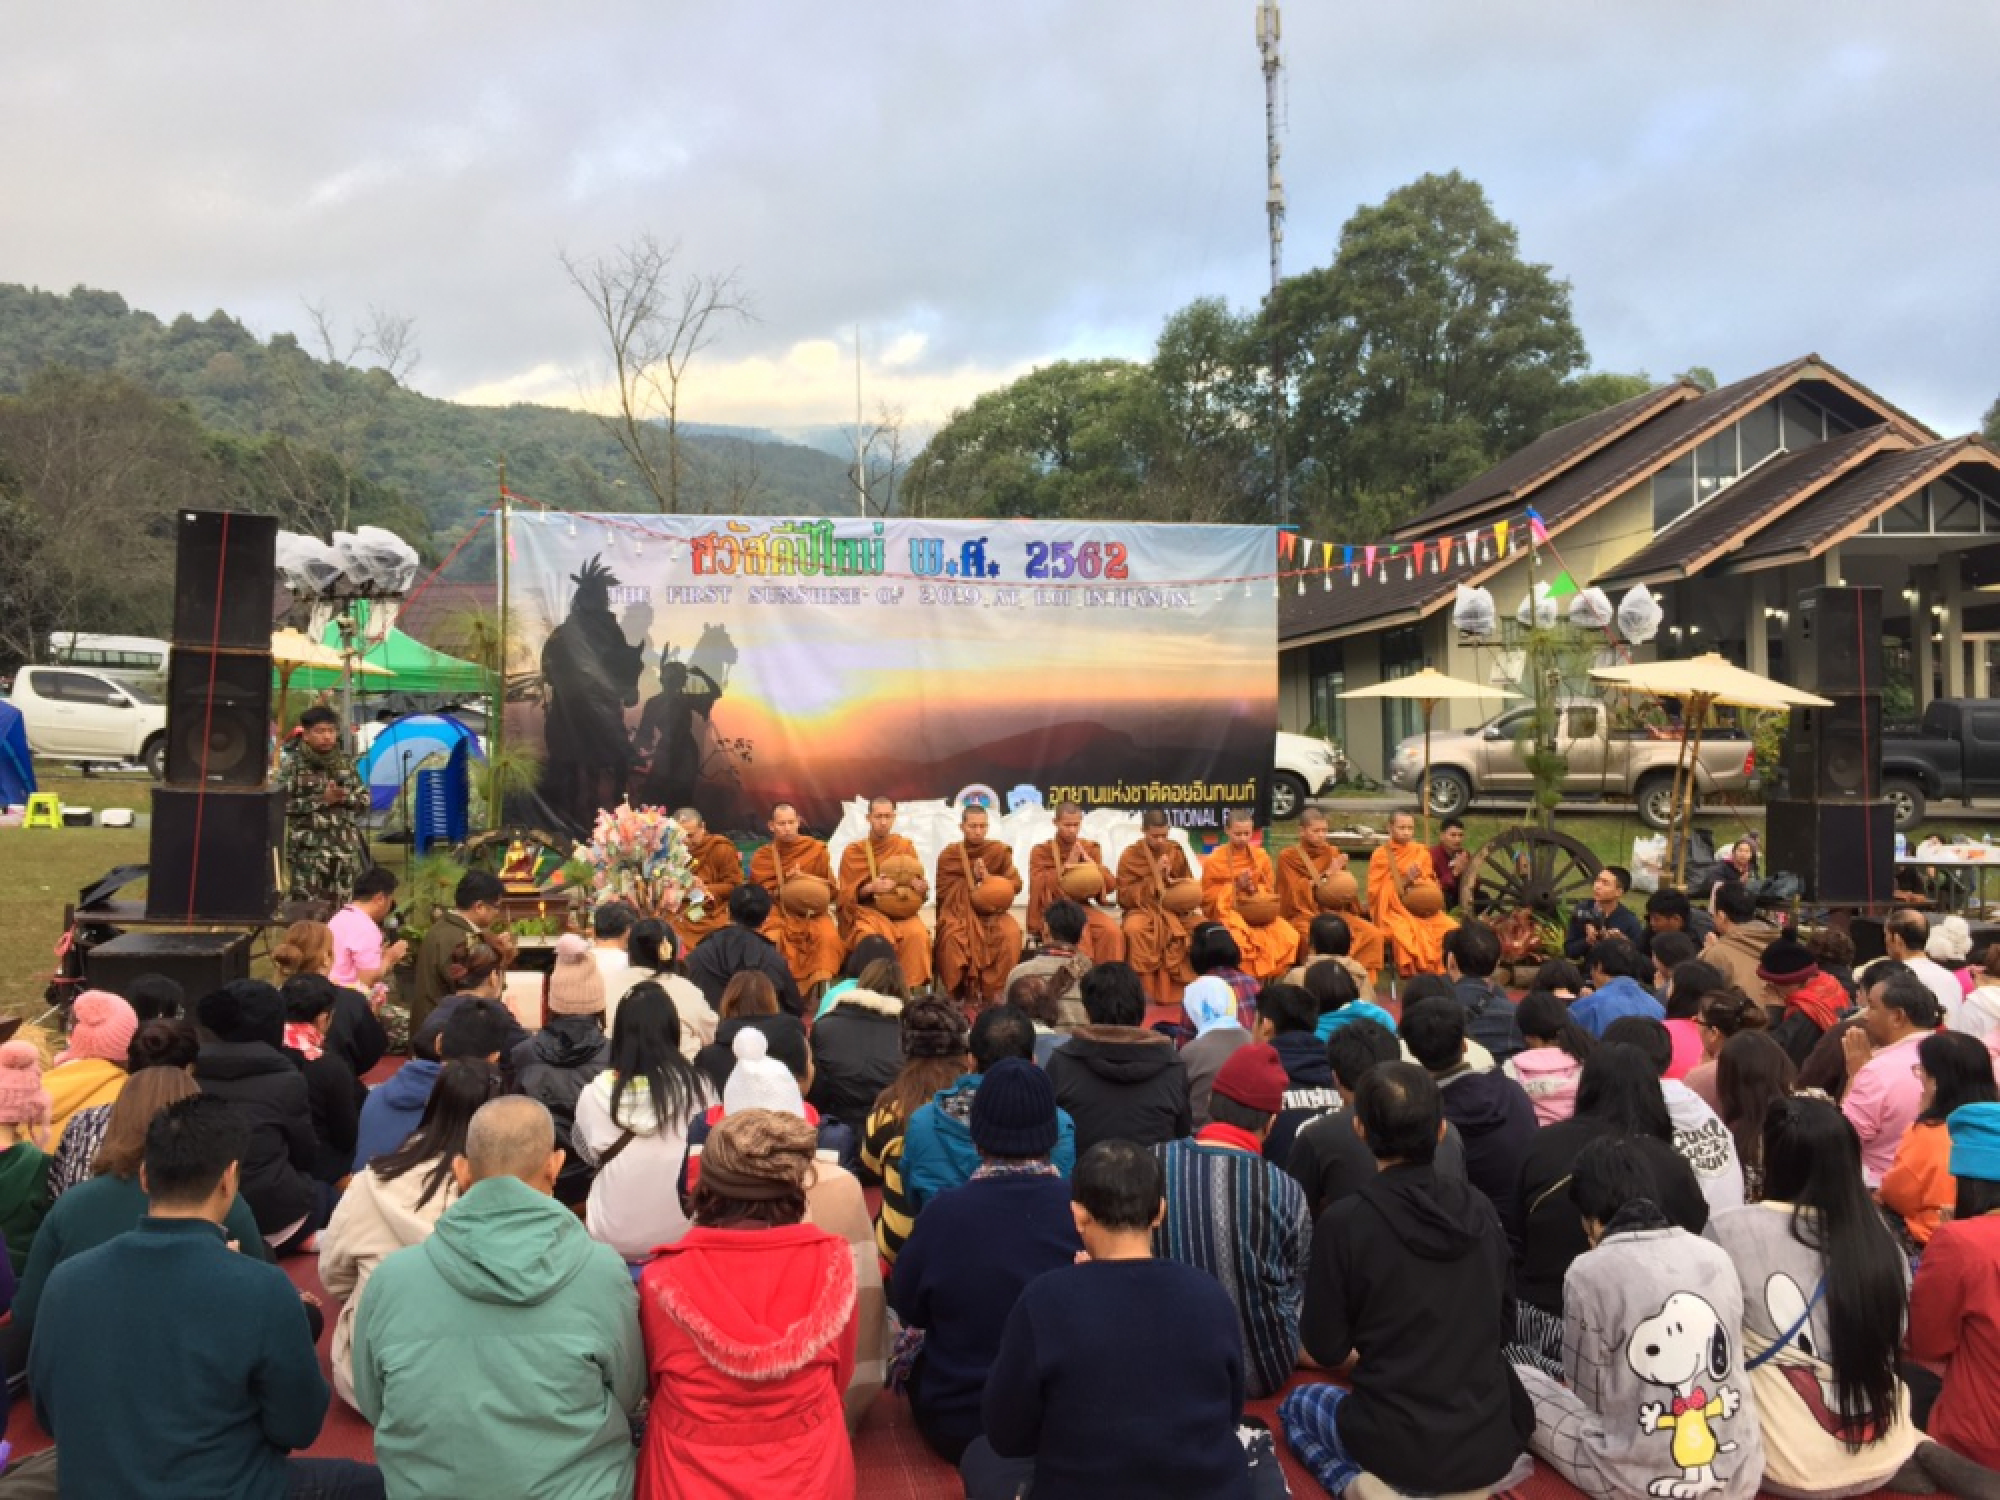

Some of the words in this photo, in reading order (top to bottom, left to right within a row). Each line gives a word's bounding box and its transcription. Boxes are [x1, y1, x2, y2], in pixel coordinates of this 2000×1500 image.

[690, 518, 886, 577] สวัสดีปีใหม่
[908, 537, 1000, 578] พ.ศ.
[1025, 541, 1129, 580] 2562
[607, 585, 652, 604] THE
[666, 585, 732, 604] FIRST
[748, 585, 861, 604] SUNSHINE
